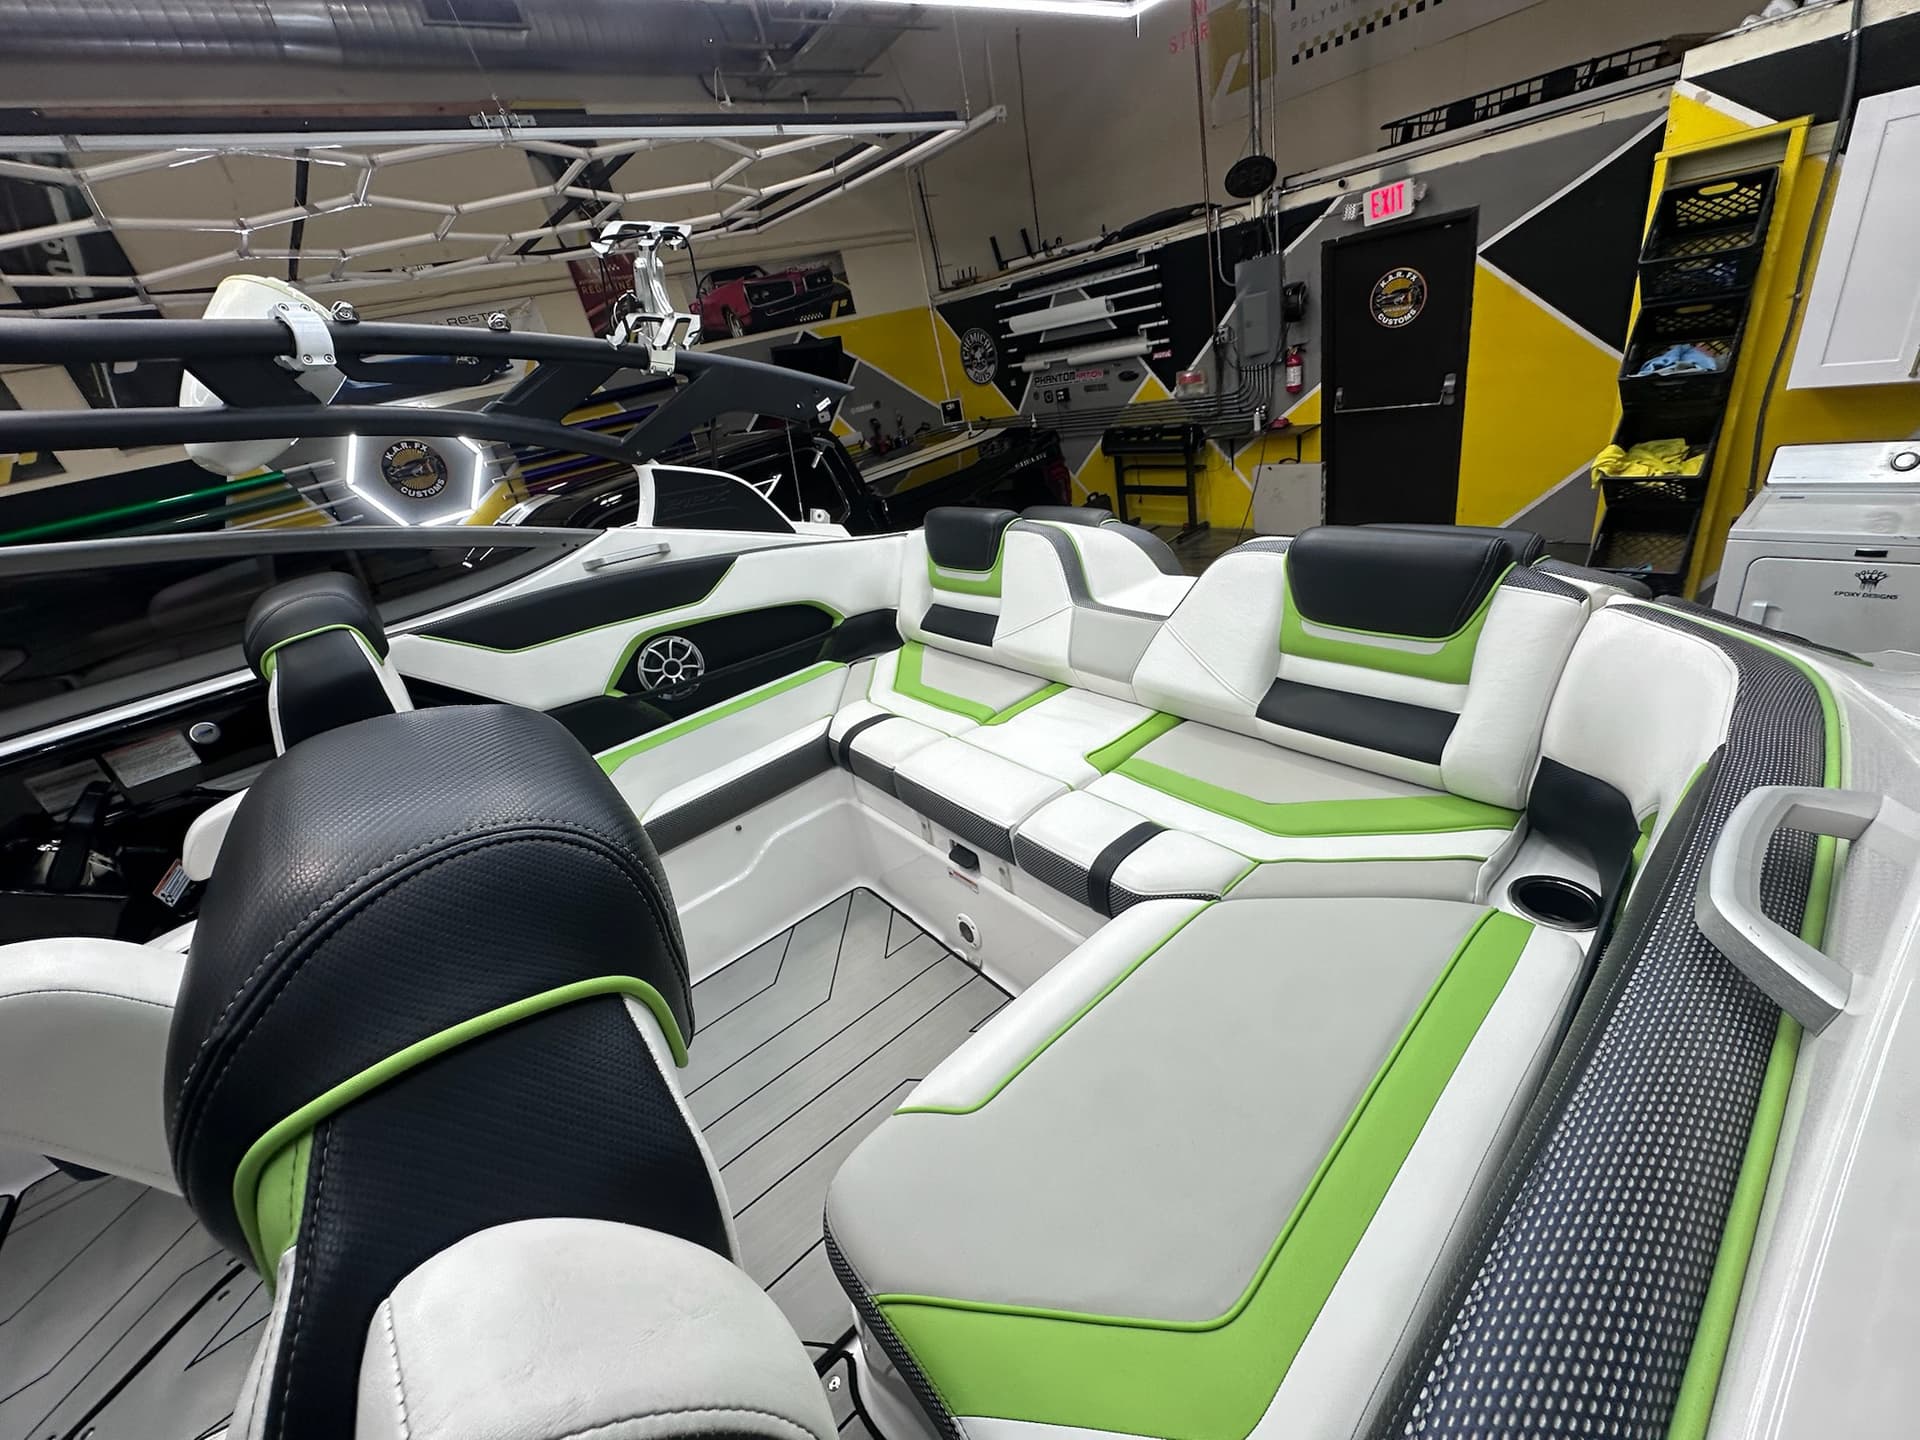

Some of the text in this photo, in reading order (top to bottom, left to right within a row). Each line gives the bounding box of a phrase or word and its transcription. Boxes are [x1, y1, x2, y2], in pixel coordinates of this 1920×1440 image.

[1370, 183, 1404, 219] EXIT
[1377, 308, 1417, 326] CUSTOMS
[414, 442, 428, 452] FX
[400, 478, 445, 498] CUSTOMS
